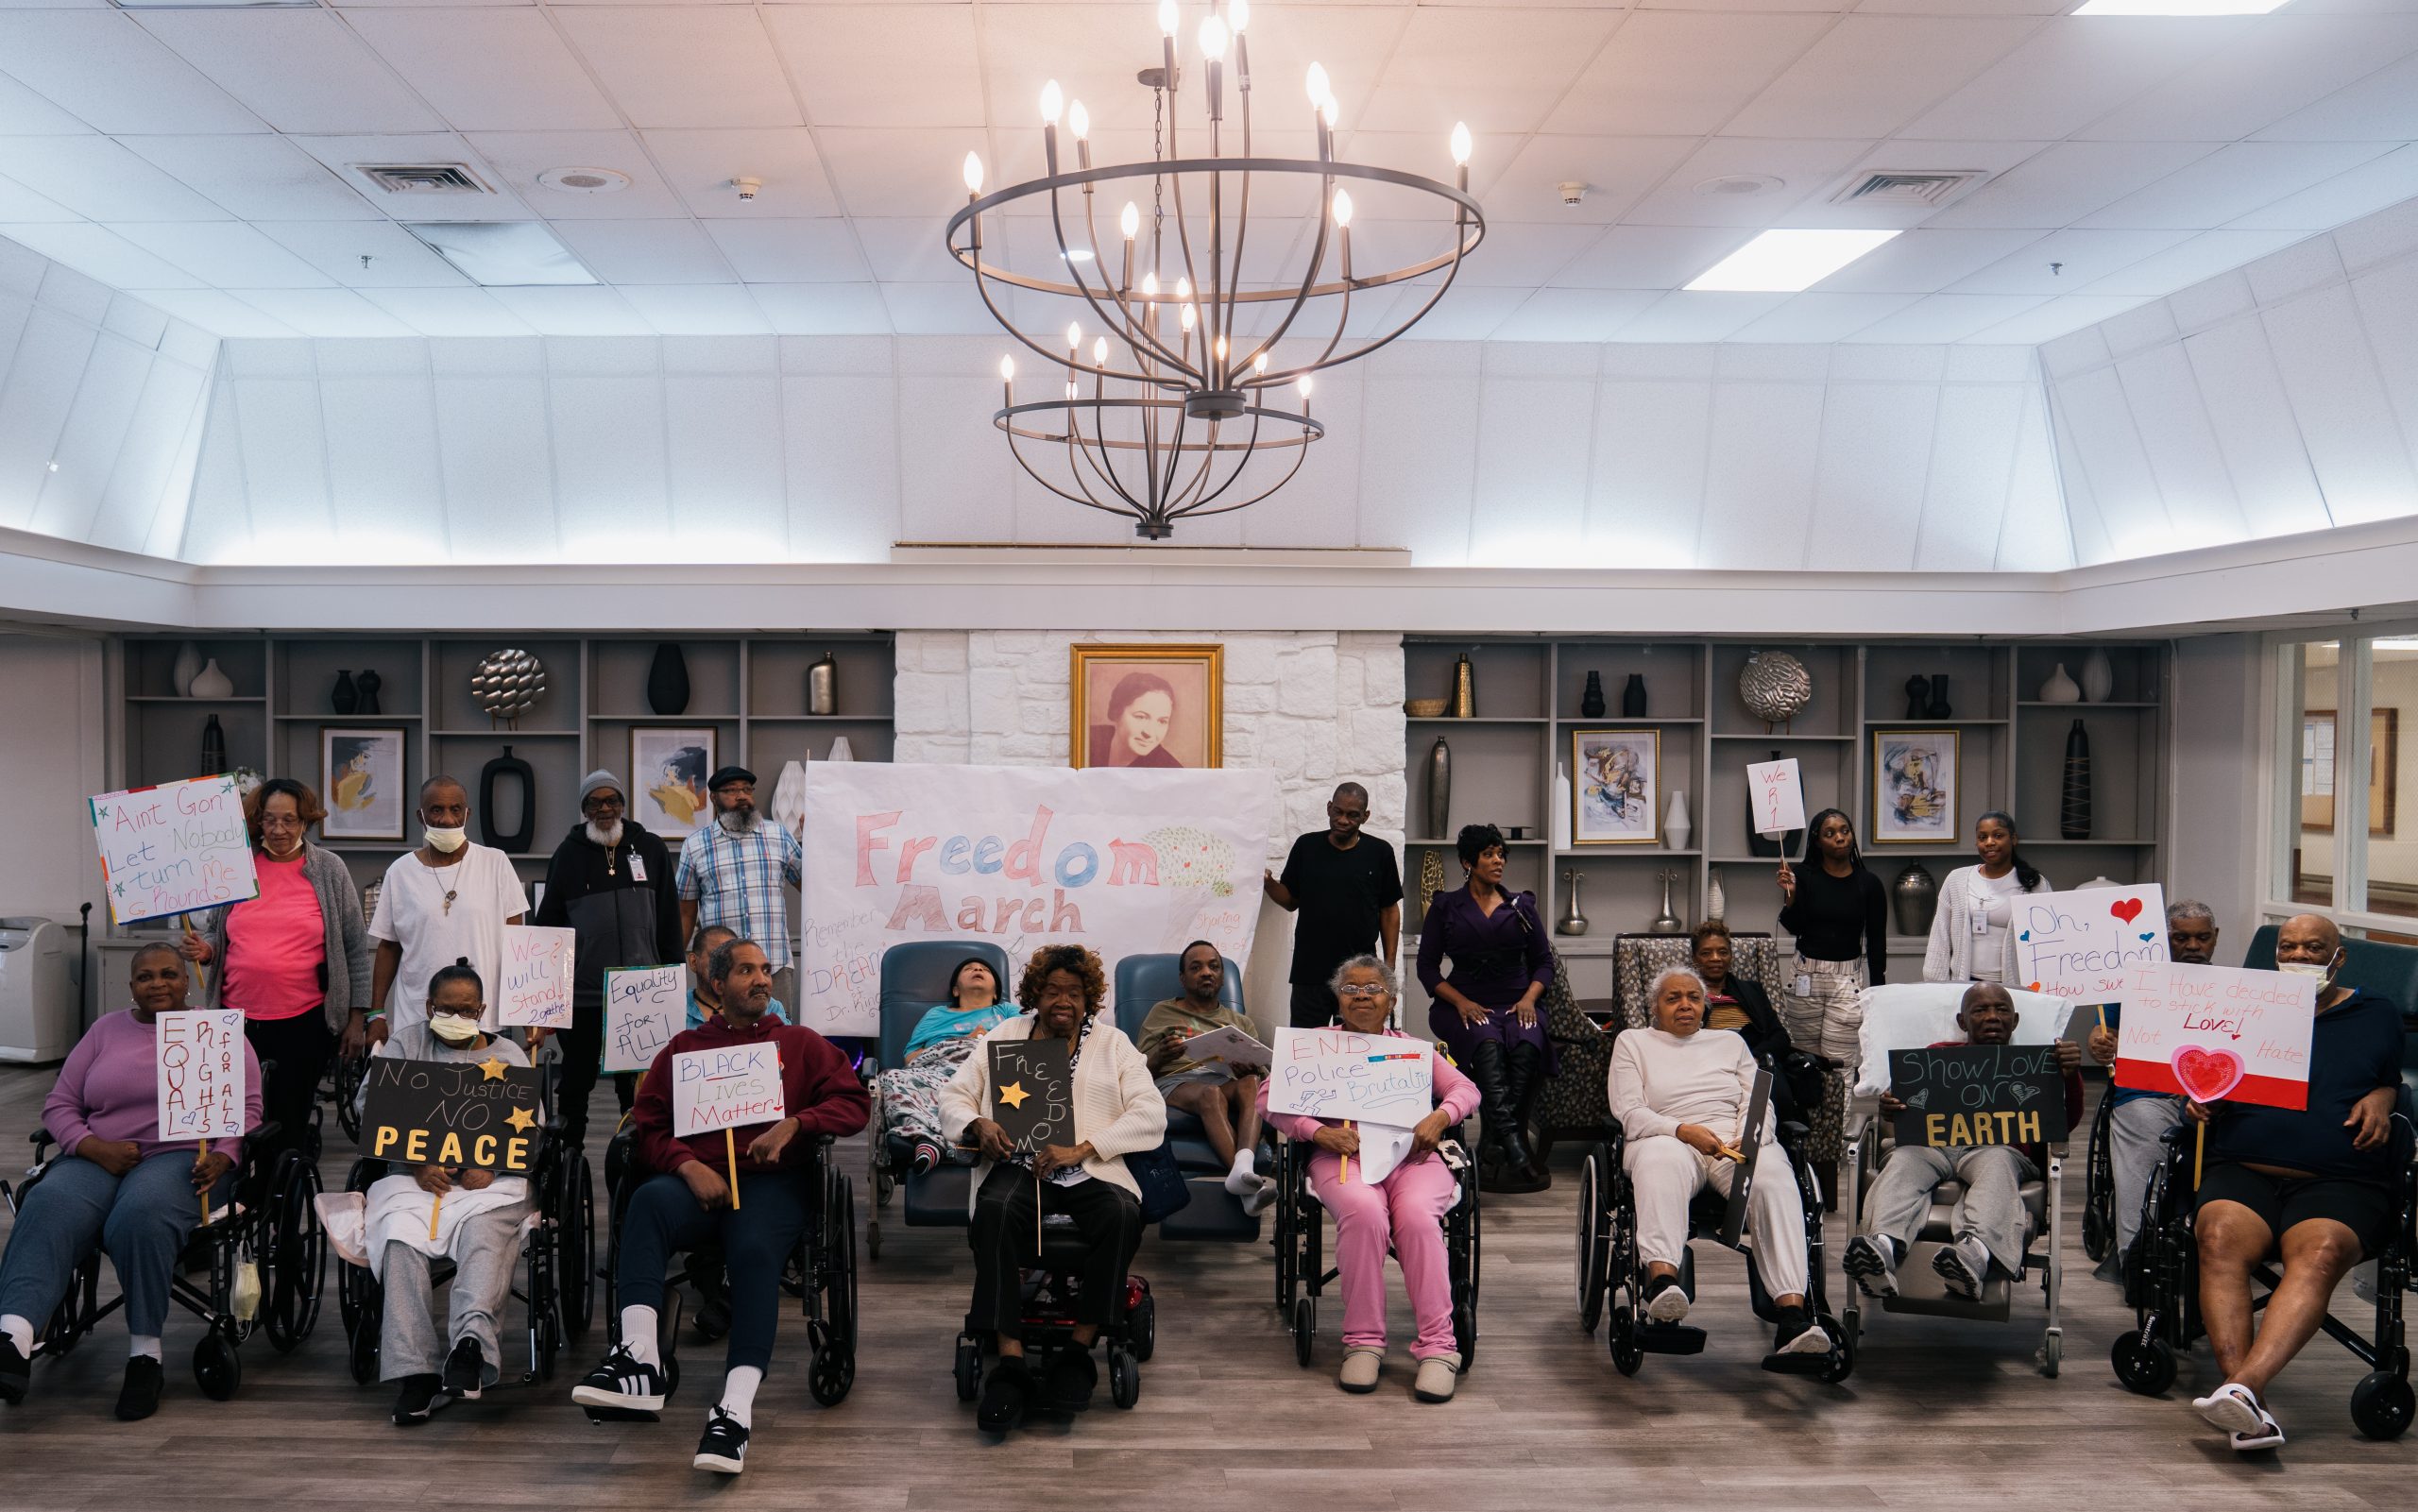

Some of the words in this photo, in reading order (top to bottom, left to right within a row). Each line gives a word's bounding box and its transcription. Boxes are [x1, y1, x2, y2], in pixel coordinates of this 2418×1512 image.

[1760, 764, 1787, 784] We
[115, 804, 167, 833] Aint
[177, 786, 223, 816] Gon
[1768, 787, 1779, 806] R
[107, 841, 156, 874] Let
[173, 816, 245, 862] Nobody
[854, 804, 1161, 888] Freedom
[128, 858, 195, 891] turn
[202, 859, 238, 882] Me
[153, 876, 214, 913] Round
[884, 883, 1087, 934] March
[804, 908, 877, 948] Remember
[2029, 904, 2090, 935] Oh,
[511, 931, 550, 961] We
[833, 941, 869, 962] the
[2028, 930, 2164, 981] Freedom
[610, 969, 677, 1004] Equality
[851, 987, 864, 998] of
[2132, 969, 2158, 992] I
[825, 1005, 850, 1021] Dr.
[2137, 997, 2162, 1009] to
[2222, 1003, 2265, 1020] with
[1292, 1033, 1371, 1061] END
[1993, 1044, 2058, 1080] LOVE
[2126, 1026, 2162, 1045] Not
[2256, 1038, 2304, 1064] Hate
[162, 1017, 189, 1136] EQUAL
[195, 1021, 215, 1133] RIGHTS
[679, 1050, 764, 1083] BLACK
[691, 1083, 784, 1130] Matter!
[1346, 1067, 1432, 1110] Brutality
[425, 1097, 490, 1130] NO
[1926, 1110, 2041, 1147] EARTH
[374, 1125, 529, 1170] PEACE
